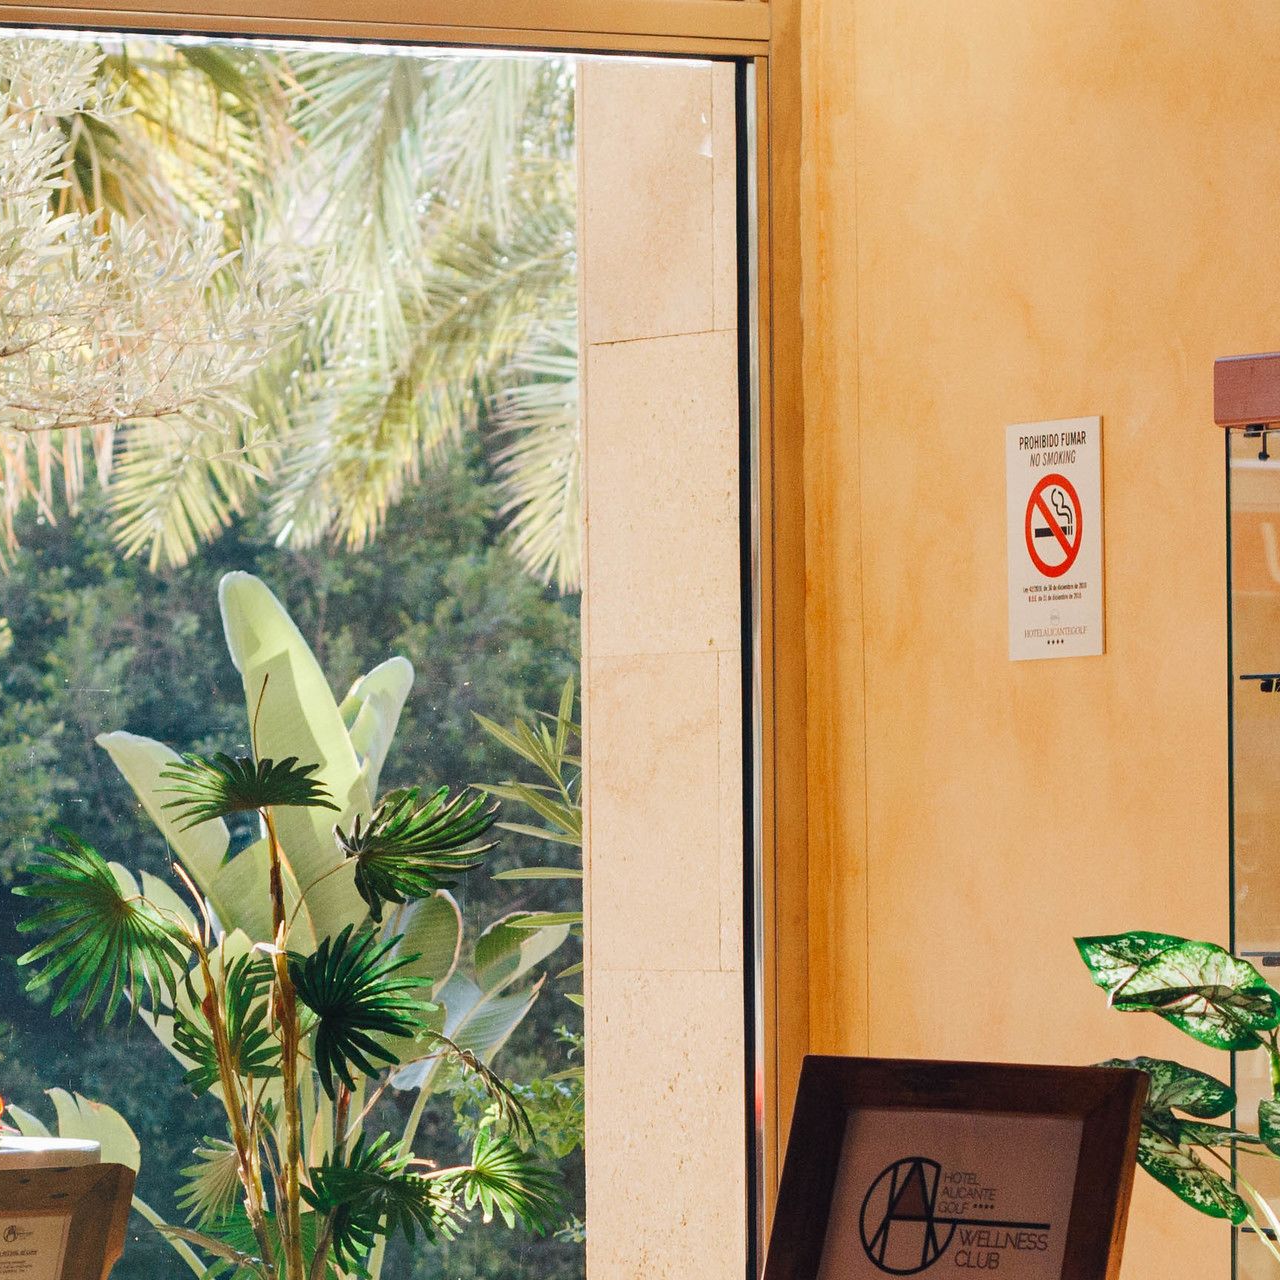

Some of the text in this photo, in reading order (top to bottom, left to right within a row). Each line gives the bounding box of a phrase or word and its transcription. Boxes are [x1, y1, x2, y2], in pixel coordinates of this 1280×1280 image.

[1019, 430, 1086, 450] PROHIBIDO FUMAR
[1030, 450, 1076, 467] NO SMOKING
[944, 1172, 980, 1186] HOTEL
[942, 1186, 997, 1200] ALICANTE
[938, 1201, 969, 1214] GOLF
[960, 1229, 1048, 1250] WELLNESS
[954, 1250, 1000, 1270] CLUB
